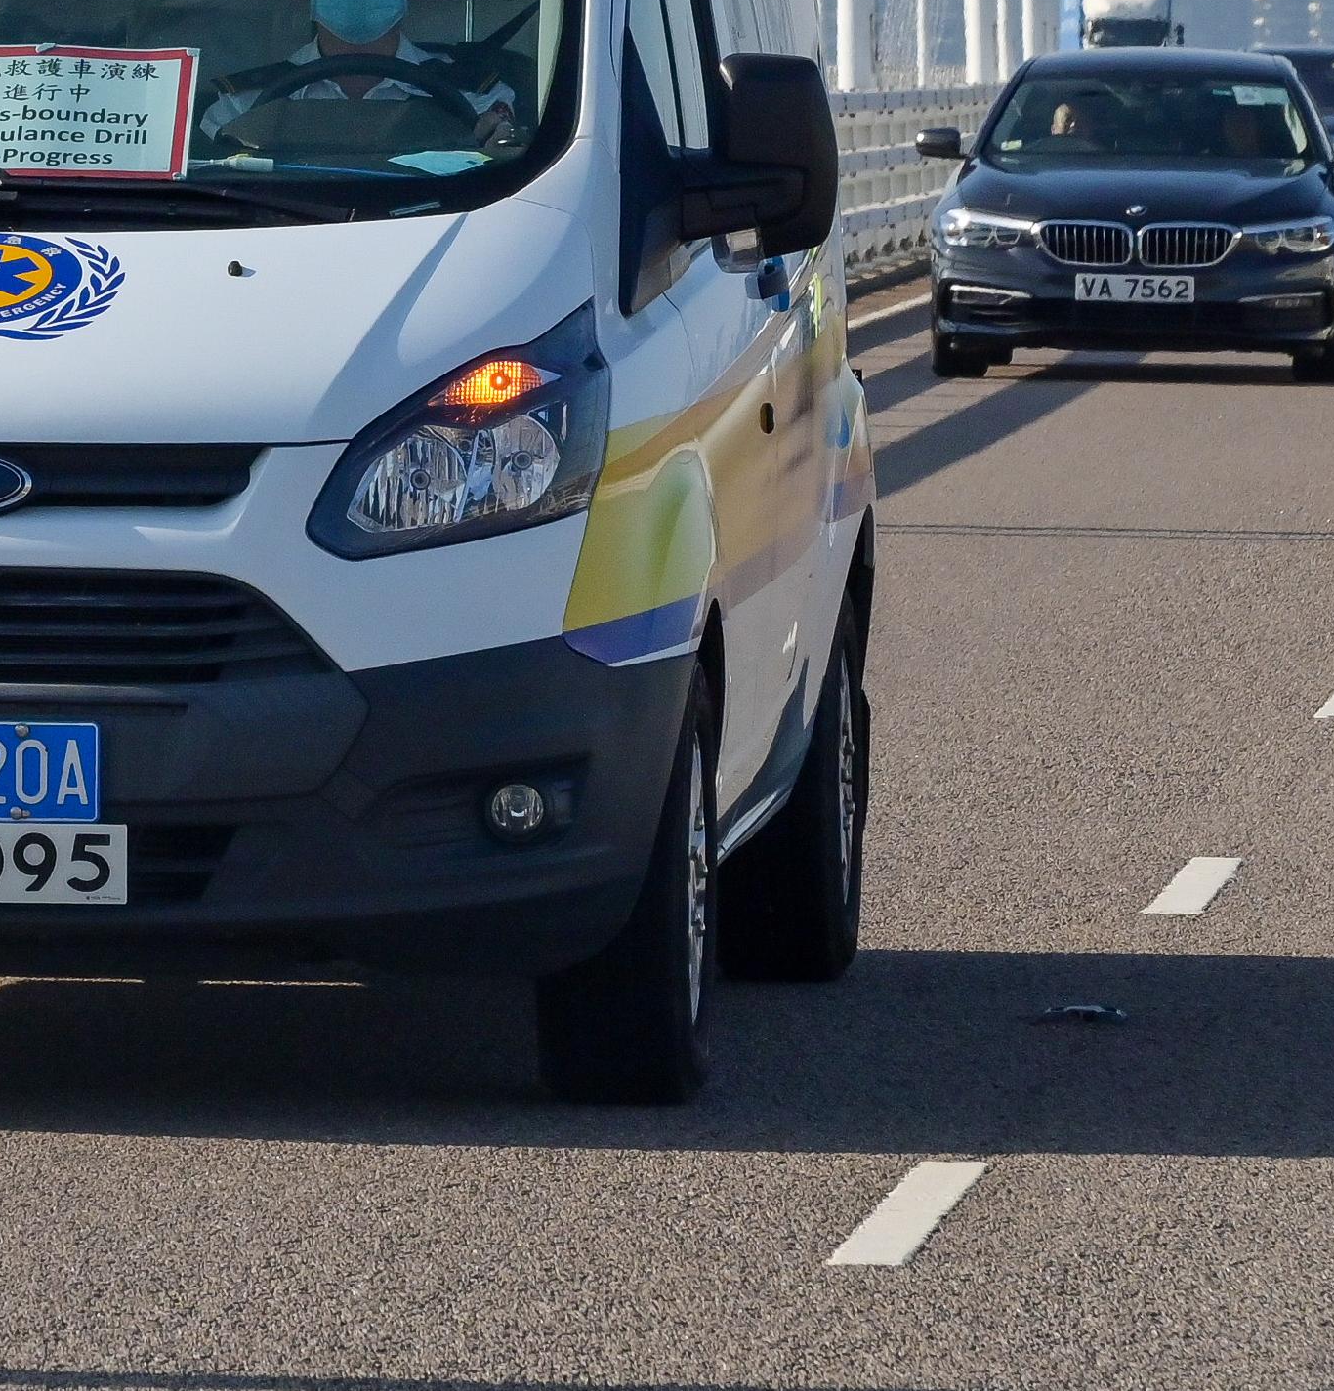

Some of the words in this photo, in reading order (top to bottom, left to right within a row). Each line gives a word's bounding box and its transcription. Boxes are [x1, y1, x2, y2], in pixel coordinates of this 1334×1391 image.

[2, 83, 92, 103] 進行中
[94, 129, 148, 145] Drill
[1081, 277, 1112, 298] VA
[1125, 278, 1189, 299] 7562
